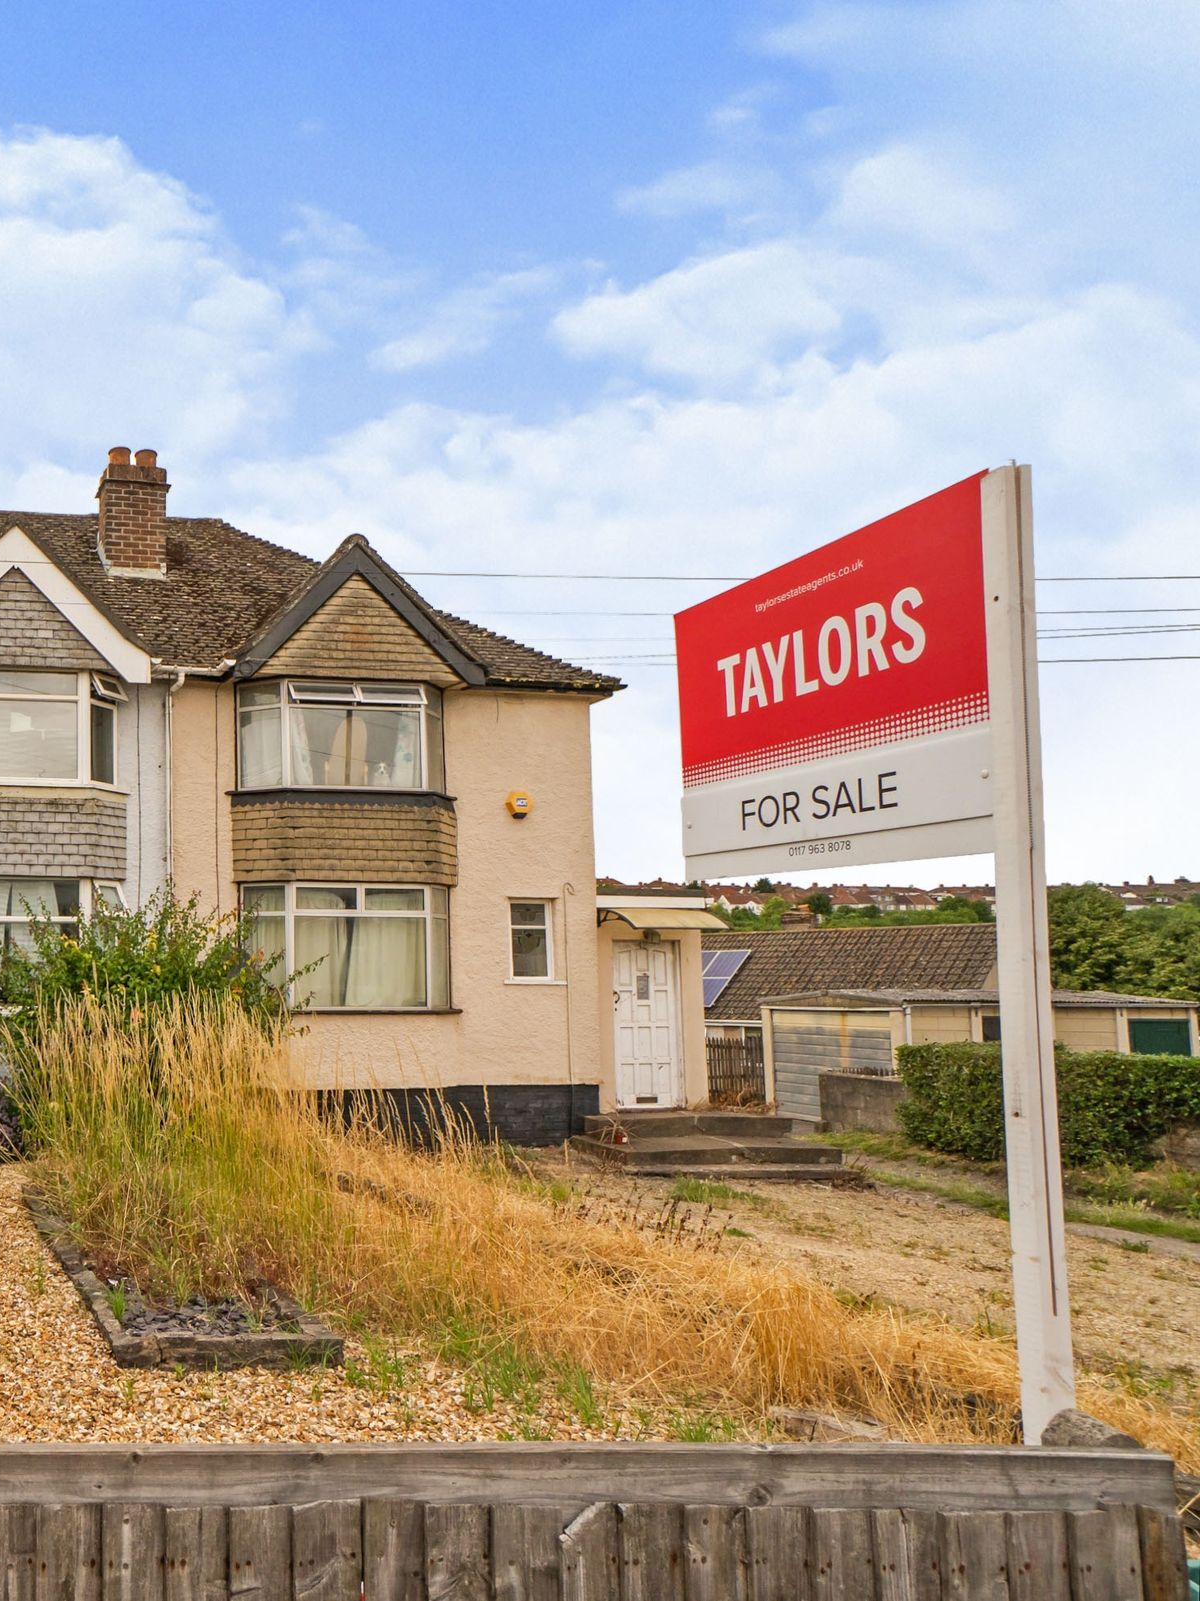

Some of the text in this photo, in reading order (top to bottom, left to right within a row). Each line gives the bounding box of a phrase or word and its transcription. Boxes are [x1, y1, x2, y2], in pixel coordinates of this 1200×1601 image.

[754, 558, 864, 612] taylorsestateagents.co.uk
[717, 586, 926, 718] TAYLORS
[741, 771, 899, 831] FOR SALE
[788, 840, 852, 857] 0117 963 8078
